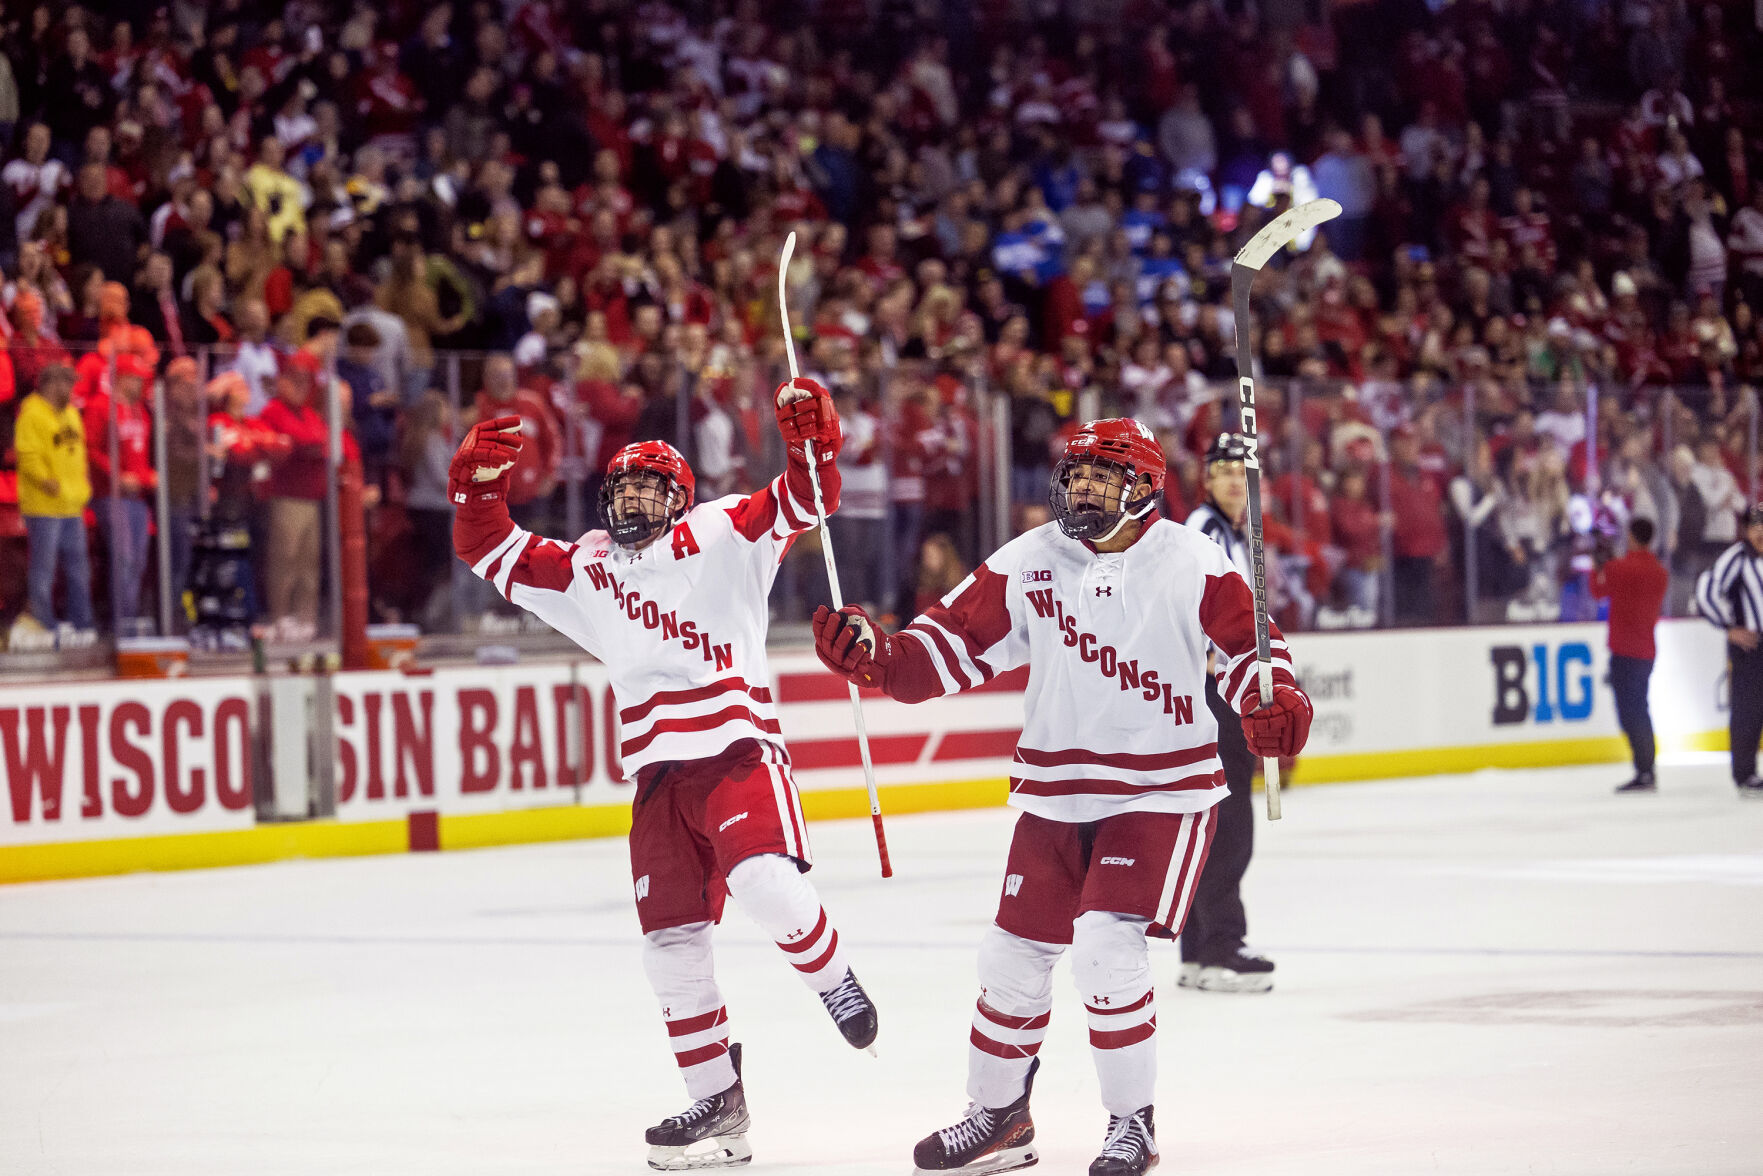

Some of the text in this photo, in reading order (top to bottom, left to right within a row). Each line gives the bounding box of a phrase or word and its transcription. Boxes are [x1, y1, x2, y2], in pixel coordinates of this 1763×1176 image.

[1239, 376, 1259, 469] CCM
[822, 450, 834, 462] 12
[454, 492, 467, 504] 12
[671, 521, 701, 561] A
[1251, 527, 1267, 624] JETSPEED
[1025, 588, 1194, 726] WISCONSIN
[719, 811, 749, 833] CCM
[1100, 856, 1136, 867] CCM
[1004, 873, 1024, 897] W
